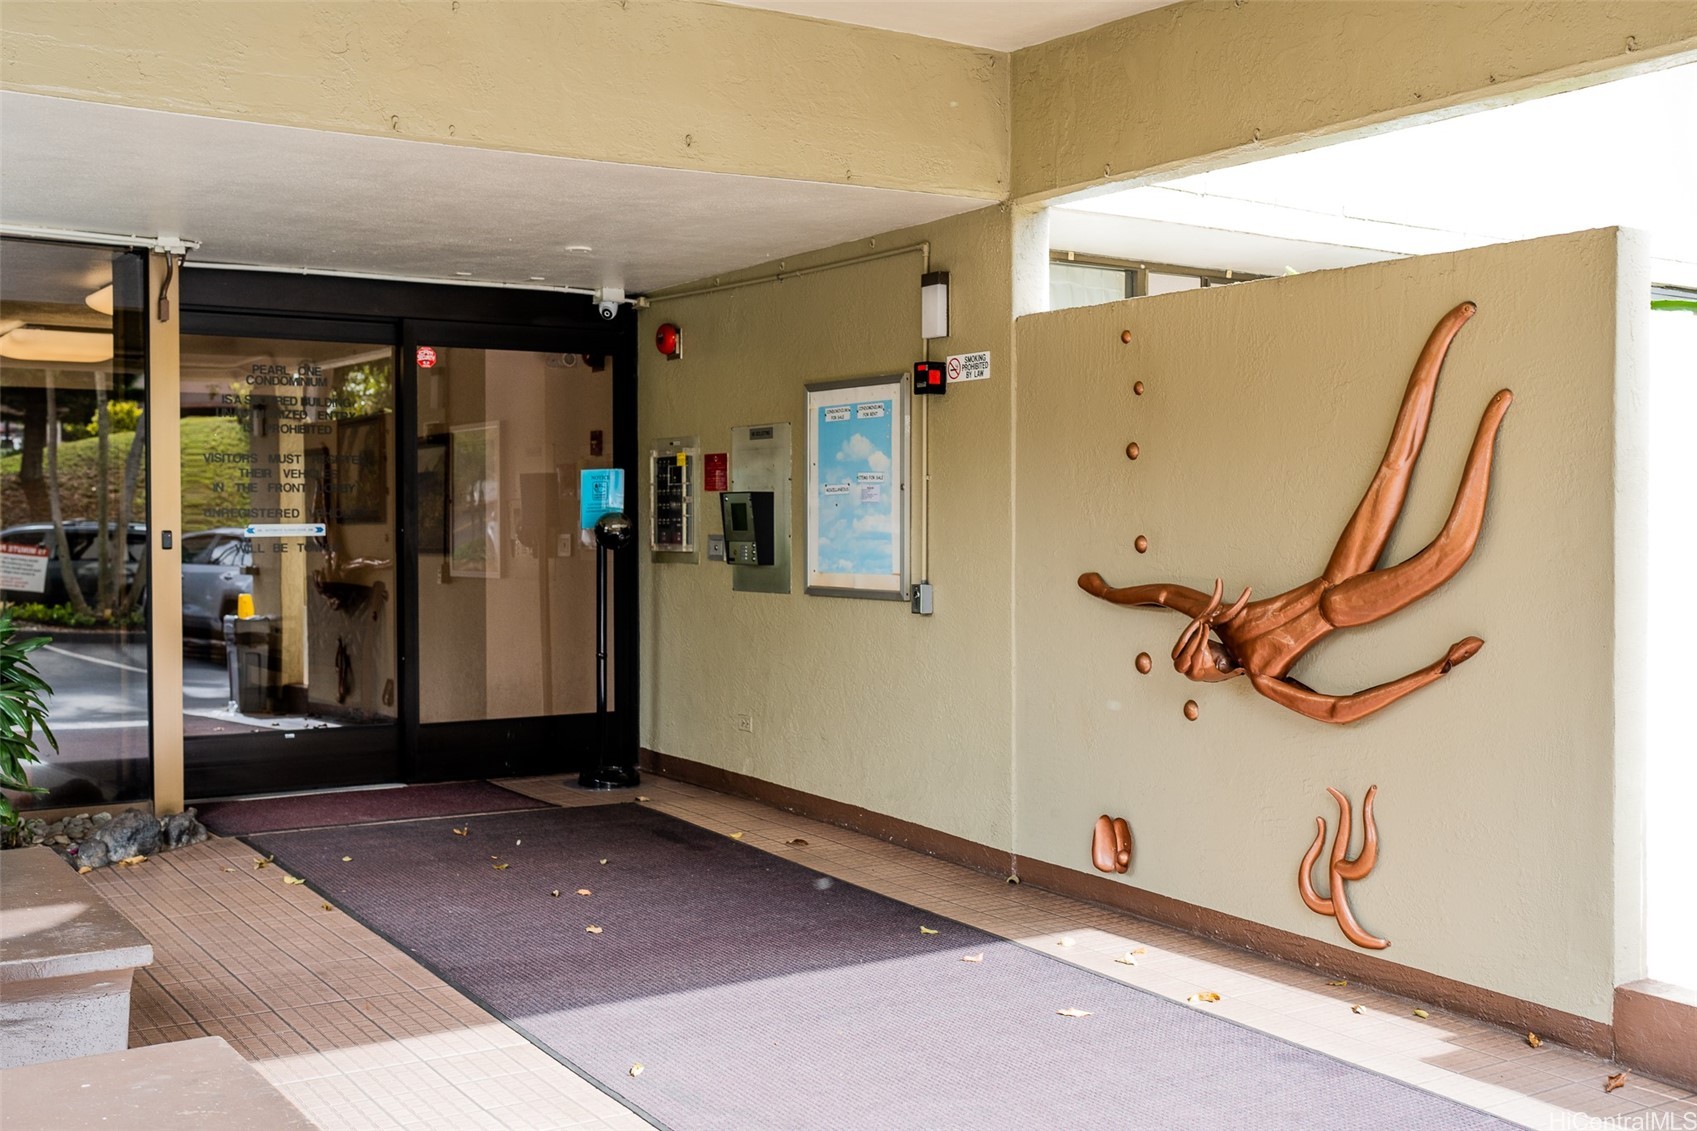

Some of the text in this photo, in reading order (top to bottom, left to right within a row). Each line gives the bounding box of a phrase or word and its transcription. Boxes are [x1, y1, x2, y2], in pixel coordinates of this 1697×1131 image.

[964, 353, 987, 363] SMOKING
[252, 364, 322, 376] PEARL ONE
[962, 361, 989, 371] PROHIBITED
[965, 370, 985, 379] BY LAW
[245, 374, 327, 387] CONDOMINIUM
[221, 394, 233, 404] IS
[233, 395, 242, 405] A
[316, 411, 356, 421] ENTRY
[202, 453, 258, 464] VISITORS
[268, 454, 301, 464] MUST
[238, 468, 272, 478] THEIR
[212, 482, 225, 492] IN
[235, 482, 258, 492] THE
[267, 482, 306, 492] FRONT
[202, 508, 300, 518] UNREGISTERED
[273, 544, 288, 553] BE
